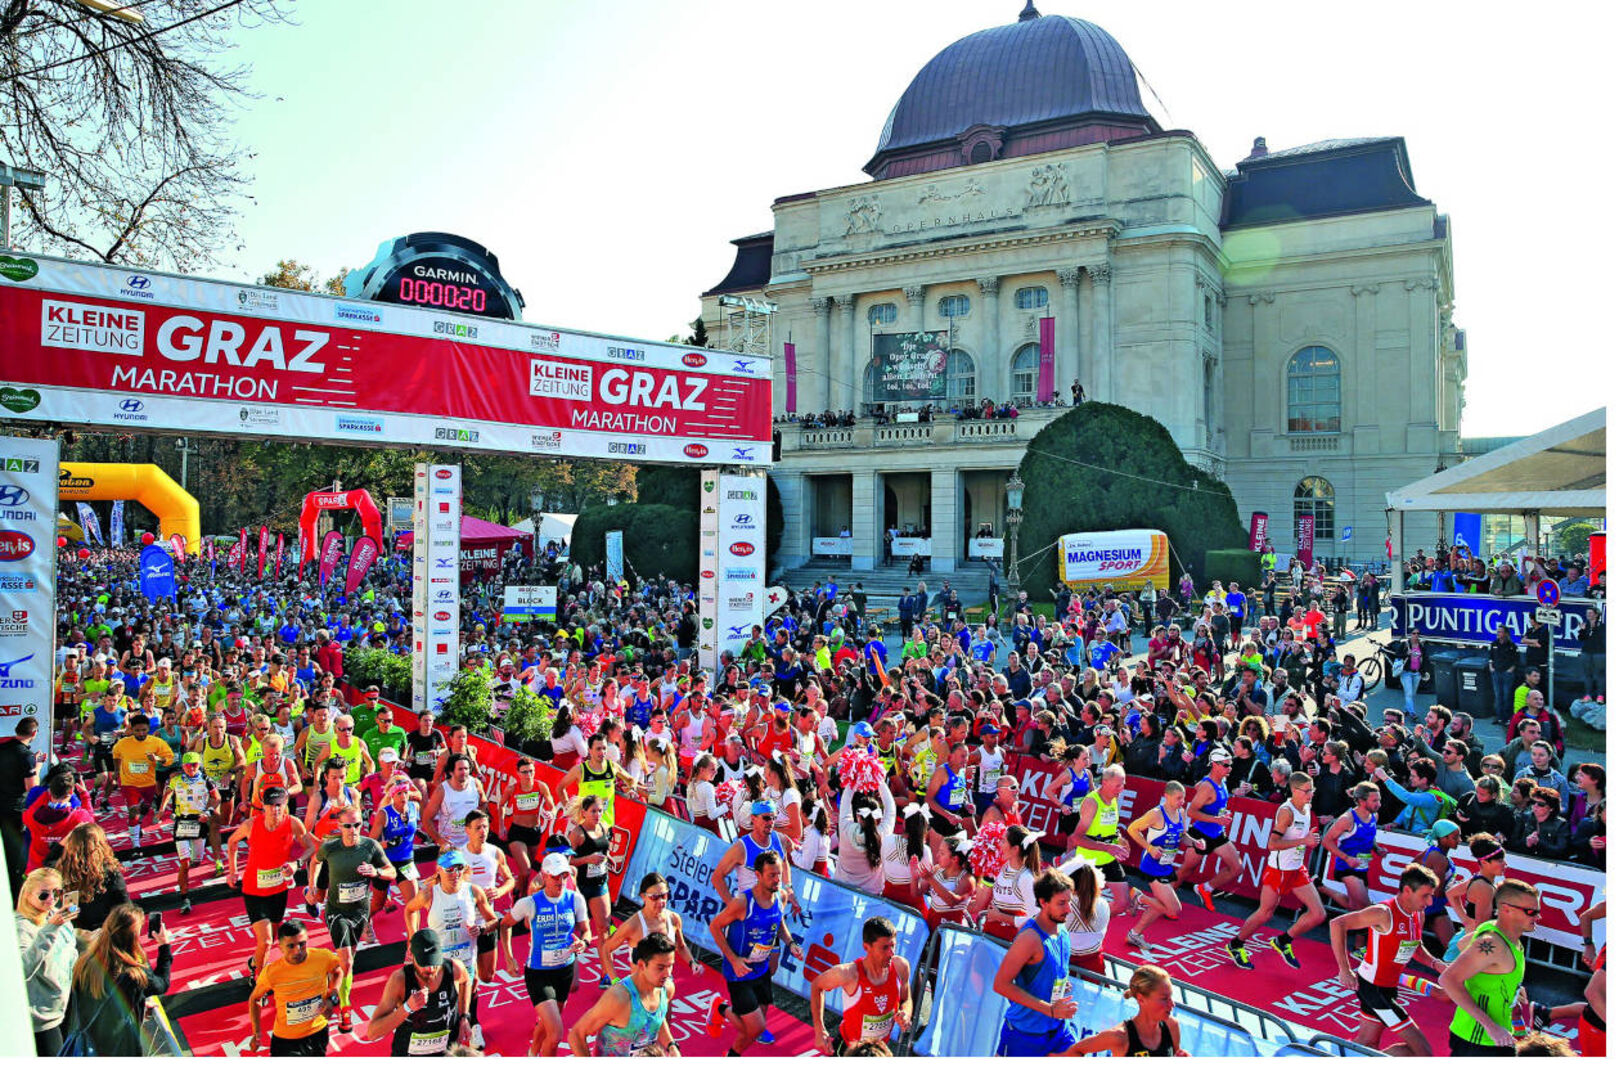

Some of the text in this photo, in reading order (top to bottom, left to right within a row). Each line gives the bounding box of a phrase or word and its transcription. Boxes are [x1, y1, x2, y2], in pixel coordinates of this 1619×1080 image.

[892, 208, 1013, 232] OPERNHAUS
[414, 265, 479, 285] GARMIN
[120, 288, 154, 299] HYUNDAI
[400, 278, 486, 312] 00:00:20
[48, 305, 139, 331] KLEINE
[338, 312, 373, 321] SPARKASSE
[47, 325, 139, 350] ZEITUNG
[434, 321, 478, 339] GRAZ
[156, 315, 331, 374] GRAZ
[607, 347, 645, 361] GRAZ
[111, 365, 279, 400] MARATHON
[534, 363, 589, 383] KLEINE
[533, 378, 589, 397] ZEITUNG
[600, 368, 709, 412] GRAZ
[114, 412, 148, 421] HYUNDAI
[571, 408, 677, 434] MARATHON
[339, 424, 374, 432] SPARKASSE
[435, 428, 479, 442] GRAZ
[608, 442, 646, 455] GRAZ
[318, 497, 338, 506] SPAR
[1254, 519, 1265, 552] KLEINE
[460, 549, 497, 560] KLEINE
[1068, 549, 1142, 563] MAGNESIUM
[1098, 560, 1142, 571] SPORT
[517, 597, 544, 605] BLOCK
[1020, 768, 1138, 819] KLE
[1379, 852, 1585, 927] SPR
[1128, 921, 1242, 963] KLEINE
